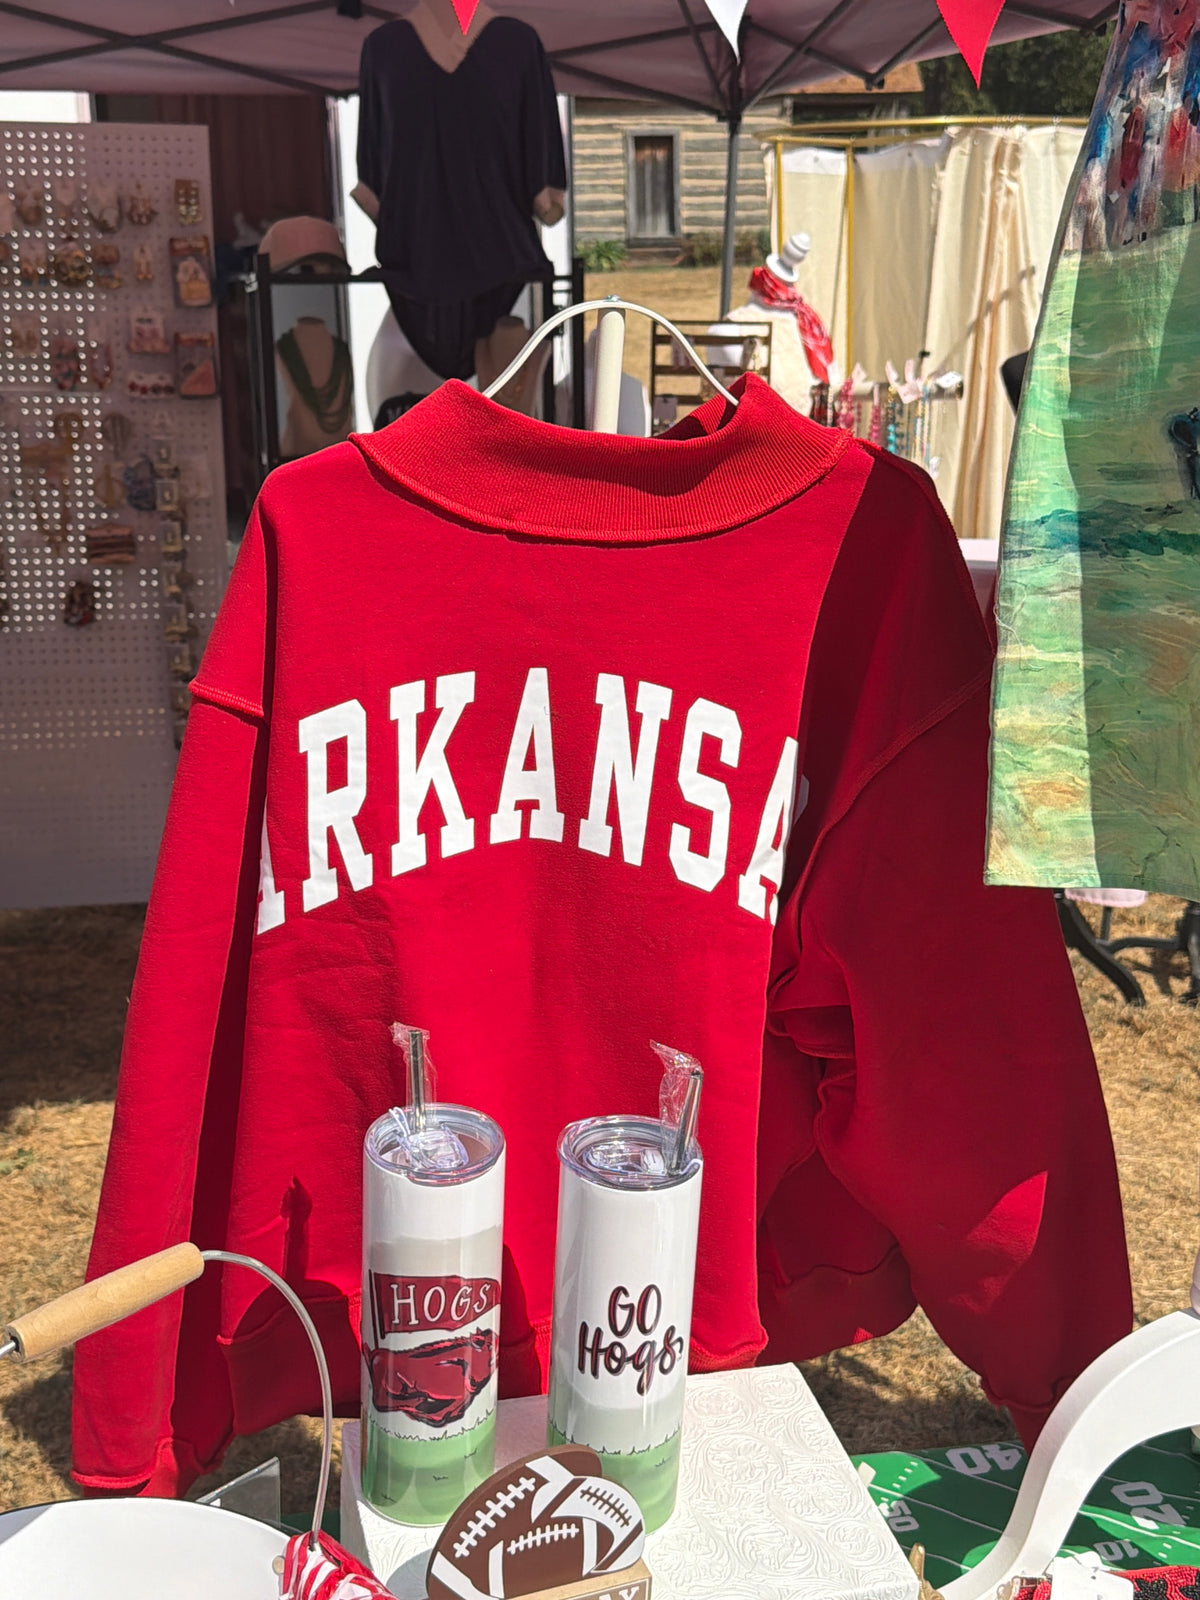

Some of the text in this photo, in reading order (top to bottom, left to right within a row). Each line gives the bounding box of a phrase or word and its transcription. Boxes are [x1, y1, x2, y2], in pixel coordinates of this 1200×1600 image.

[390, 1283, 491, 1326] HOGS
[608, 1284, 662, 1338] GO
[578, 1321, 684, 1396] Hogs
[945, 1444, 1022, 1475] 40
